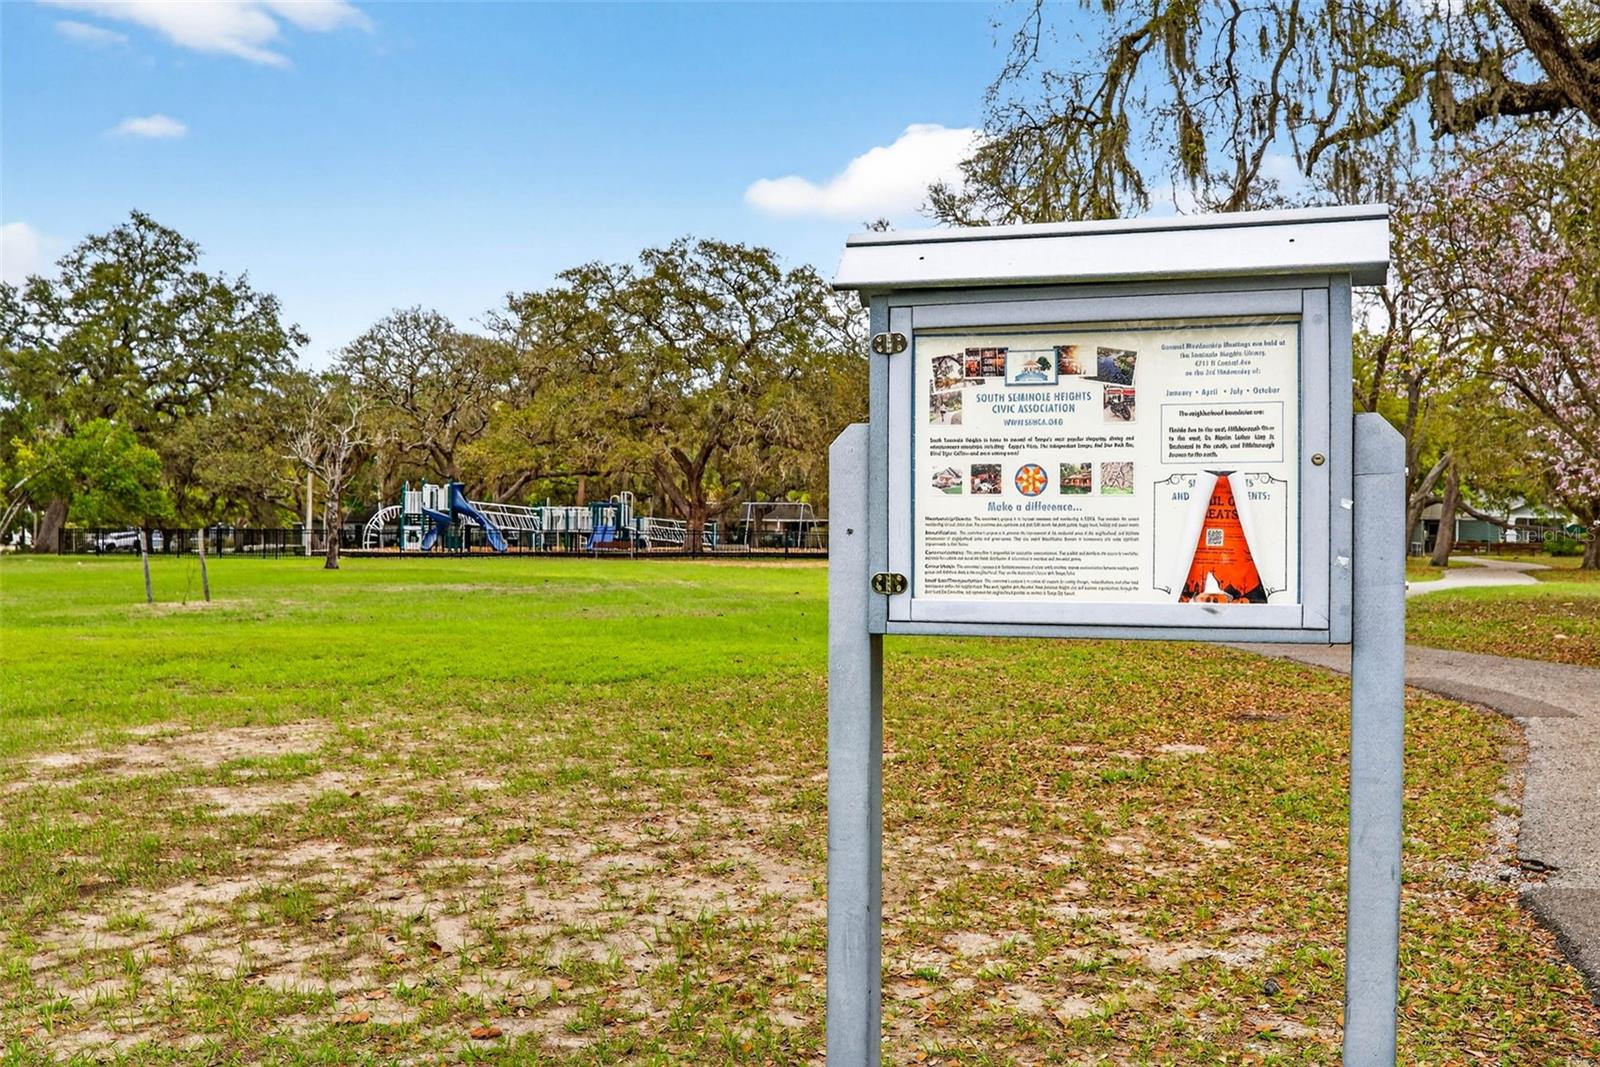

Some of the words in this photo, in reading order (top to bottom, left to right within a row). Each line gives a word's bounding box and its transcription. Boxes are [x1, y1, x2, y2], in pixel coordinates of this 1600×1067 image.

[976, 393, 1005, 403] SOUTH
[1008, 392, 1051, 402] SEMINOLE
[1054, 391, 1092, 401] HEIGHTS
[1166, 389, 1192, 397] January
[1201, 388, 1218, 397] April
[1229, 387, 1243, 396] July
[1252, 386, 1280, 394] October
[992, 404, 1015, 414] CIVIC
[1018, 403, 1076, 414] ASSOCIATION
[1171, 492, 1190, 501] AND
[987, 501, 1013, 512] Make
